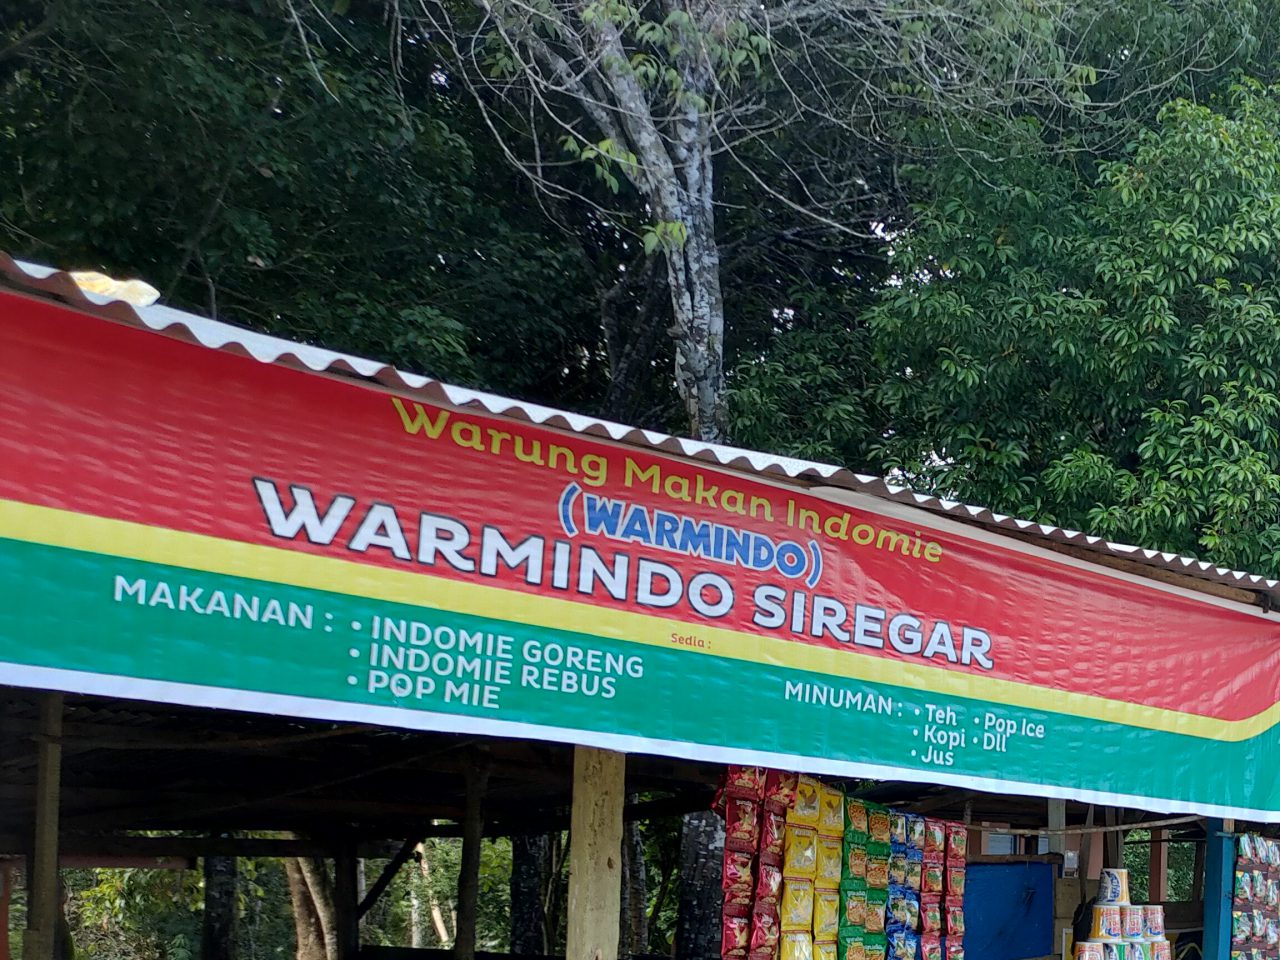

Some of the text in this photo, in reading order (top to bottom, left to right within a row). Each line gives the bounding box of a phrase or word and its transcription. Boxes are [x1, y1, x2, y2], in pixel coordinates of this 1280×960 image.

[391, 397, 943, 564] Warung Makan Indomie
[252, 476, 996, 670] WARMINDO SIREGAR
[113, 574, 314, 630] MAKANAN
[371, 615, 512, 661] INDOMIE
[522, 639, 645, 680] GORENG
[671, 631, 705, 650] Sedia
[367, 670, 501, 710] POP MIE
[369, 642, 617, 699] INDOMIE REBUS
[784, 679, 894, 718] MINUMAN
[925, 702, 958, 726] Teh
[984, 711, 1018, 737] Pop
[1021, 716, 1046, 739] Ice
[921, 745, 955, 767] Jus
[923, 723, 1008, 753] Kopi Dll
